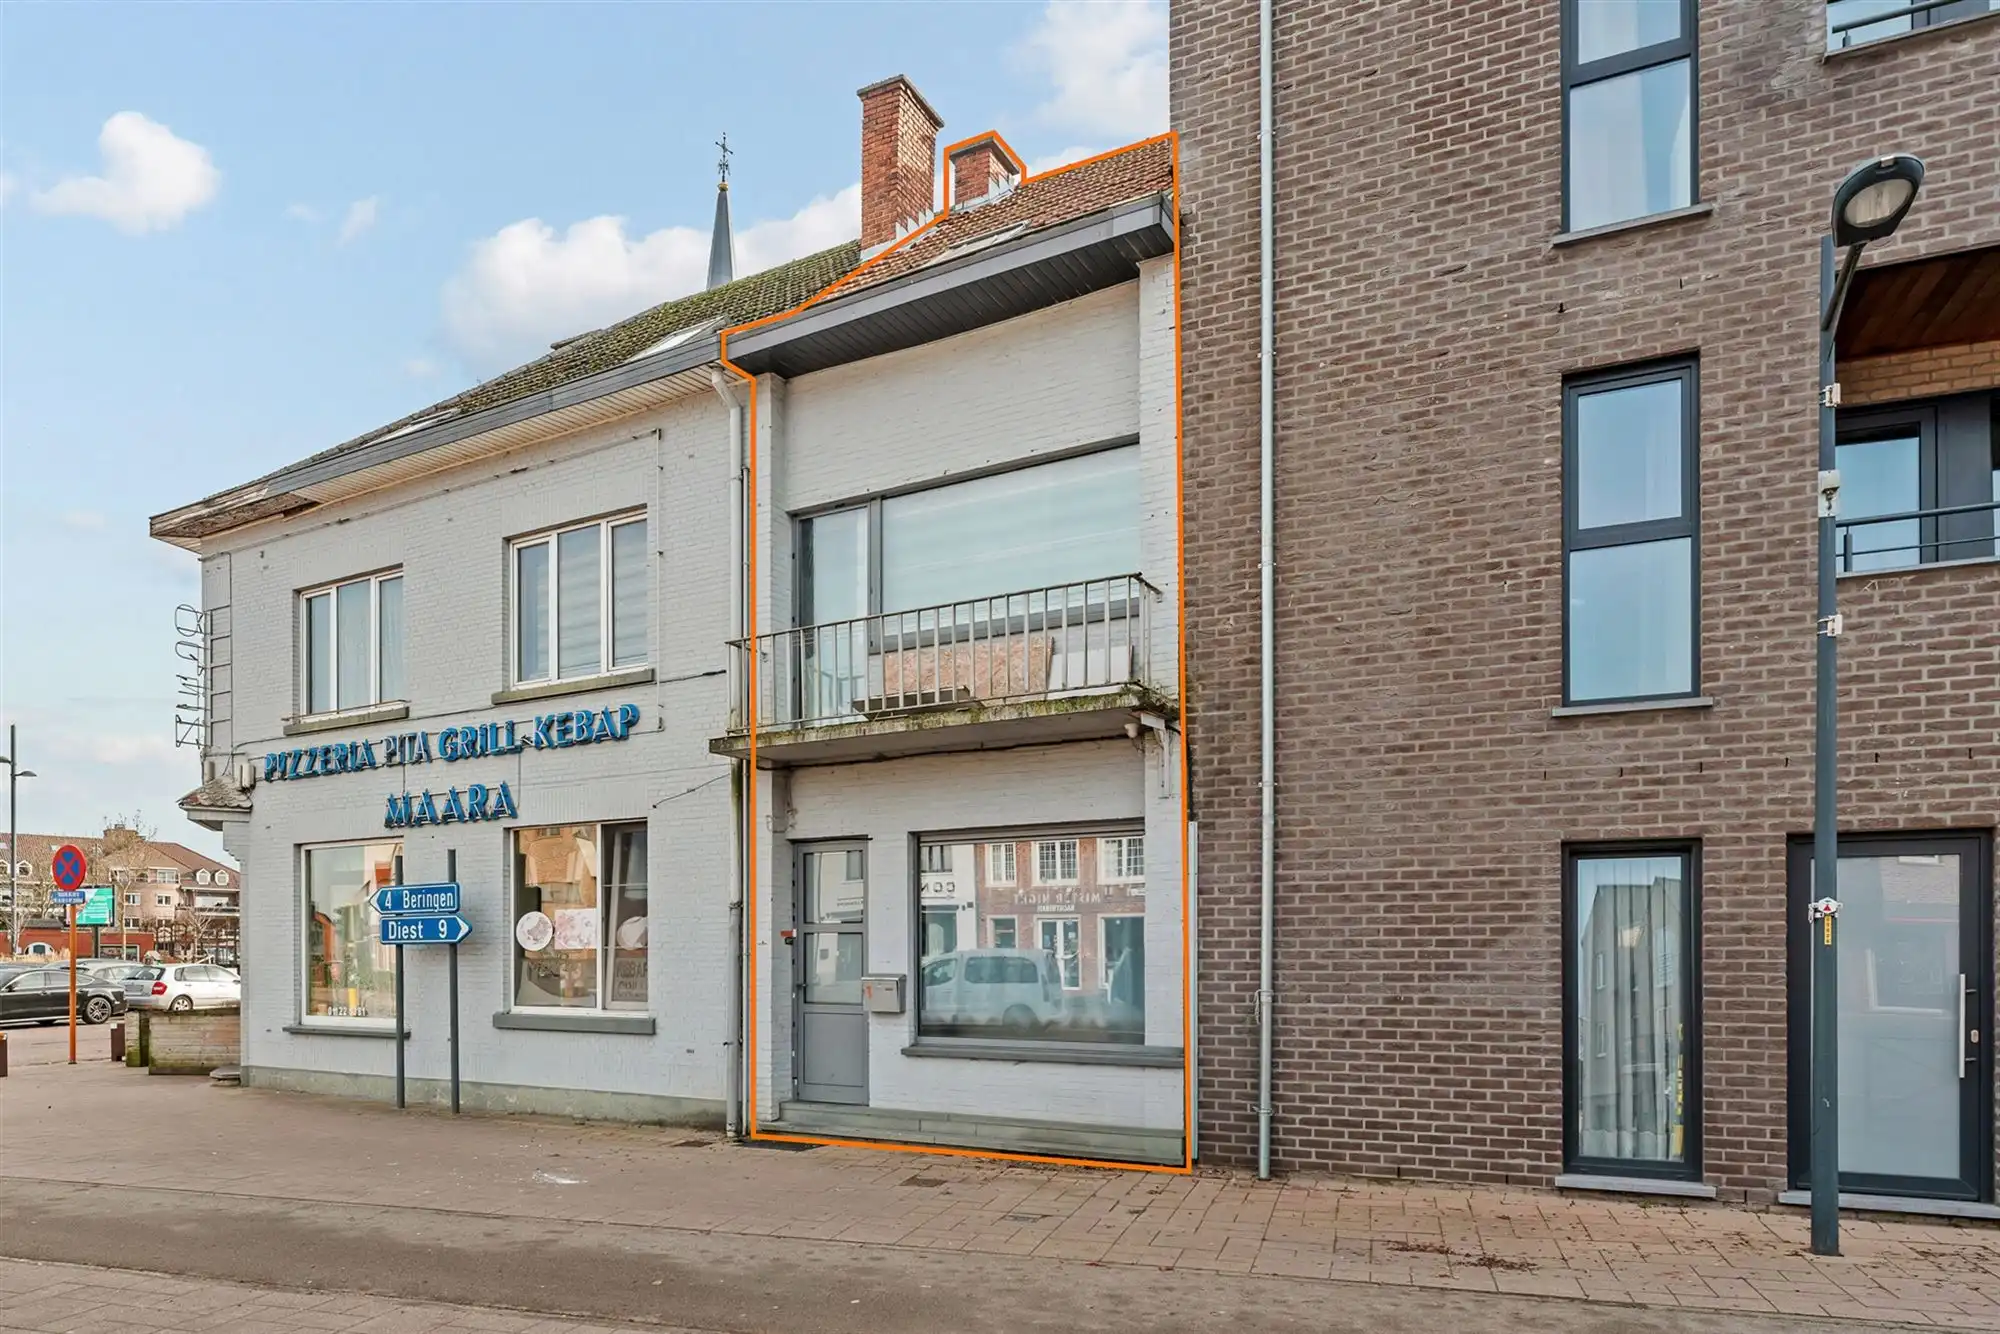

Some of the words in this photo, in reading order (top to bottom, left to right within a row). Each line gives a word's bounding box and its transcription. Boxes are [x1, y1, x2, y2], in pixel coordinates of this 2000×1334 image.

[263, 738, 377, 783] PIZZERIA
[381, 730, 433, 768] PITA
[438, 719, 524, 763] GRILL
[533, 703, 641, 750] KEBAP
[384, 780, 519, 829] MAARA
[384, 891, 392, 909] 4
[402, 889, 454, 912] Beringen
[388, 920, 424, 940] Diest
[438, 919, 448, 939] 9
